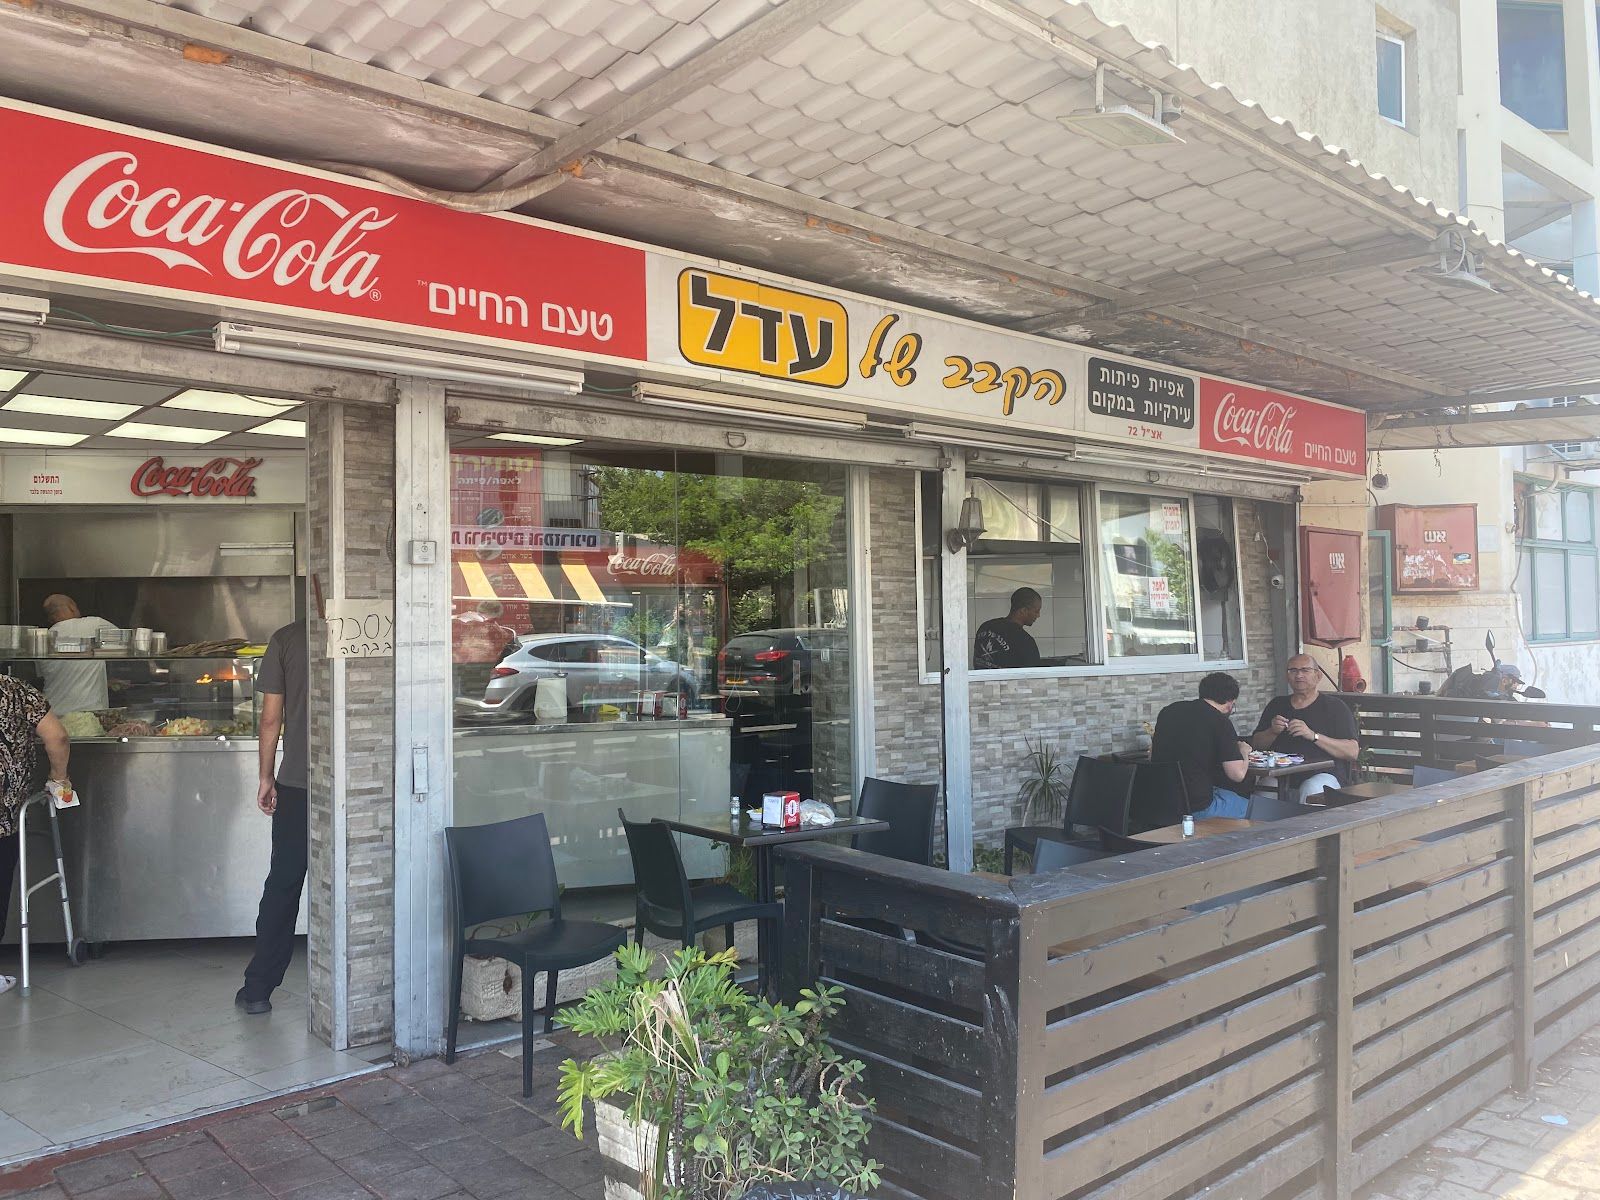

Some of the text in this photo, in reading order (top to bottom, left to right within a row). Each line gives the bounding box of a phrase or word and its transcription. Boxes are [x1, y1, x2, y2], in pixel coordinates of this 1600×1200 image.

[43, 150, 399, 299] Coca-Cola
[428, 281, 529, 328] החיים
[541, 302, 613, 341] טעם
[690, 273, 1067, 416] הקבב של עדל
[1099, 367, 1185, 398] אפיית פיתות
[1092, 390, 1191, 423] עירקיות במקום
[1213, 392, 1298, 454] Coca-Cola
[1127, 426, 1138, 436] 72
[1304, 442, 1357, 466] טעם החיים
[33, 473, 60, 484] התשלום
[130, 456, 264, 497] Coca-Cola
